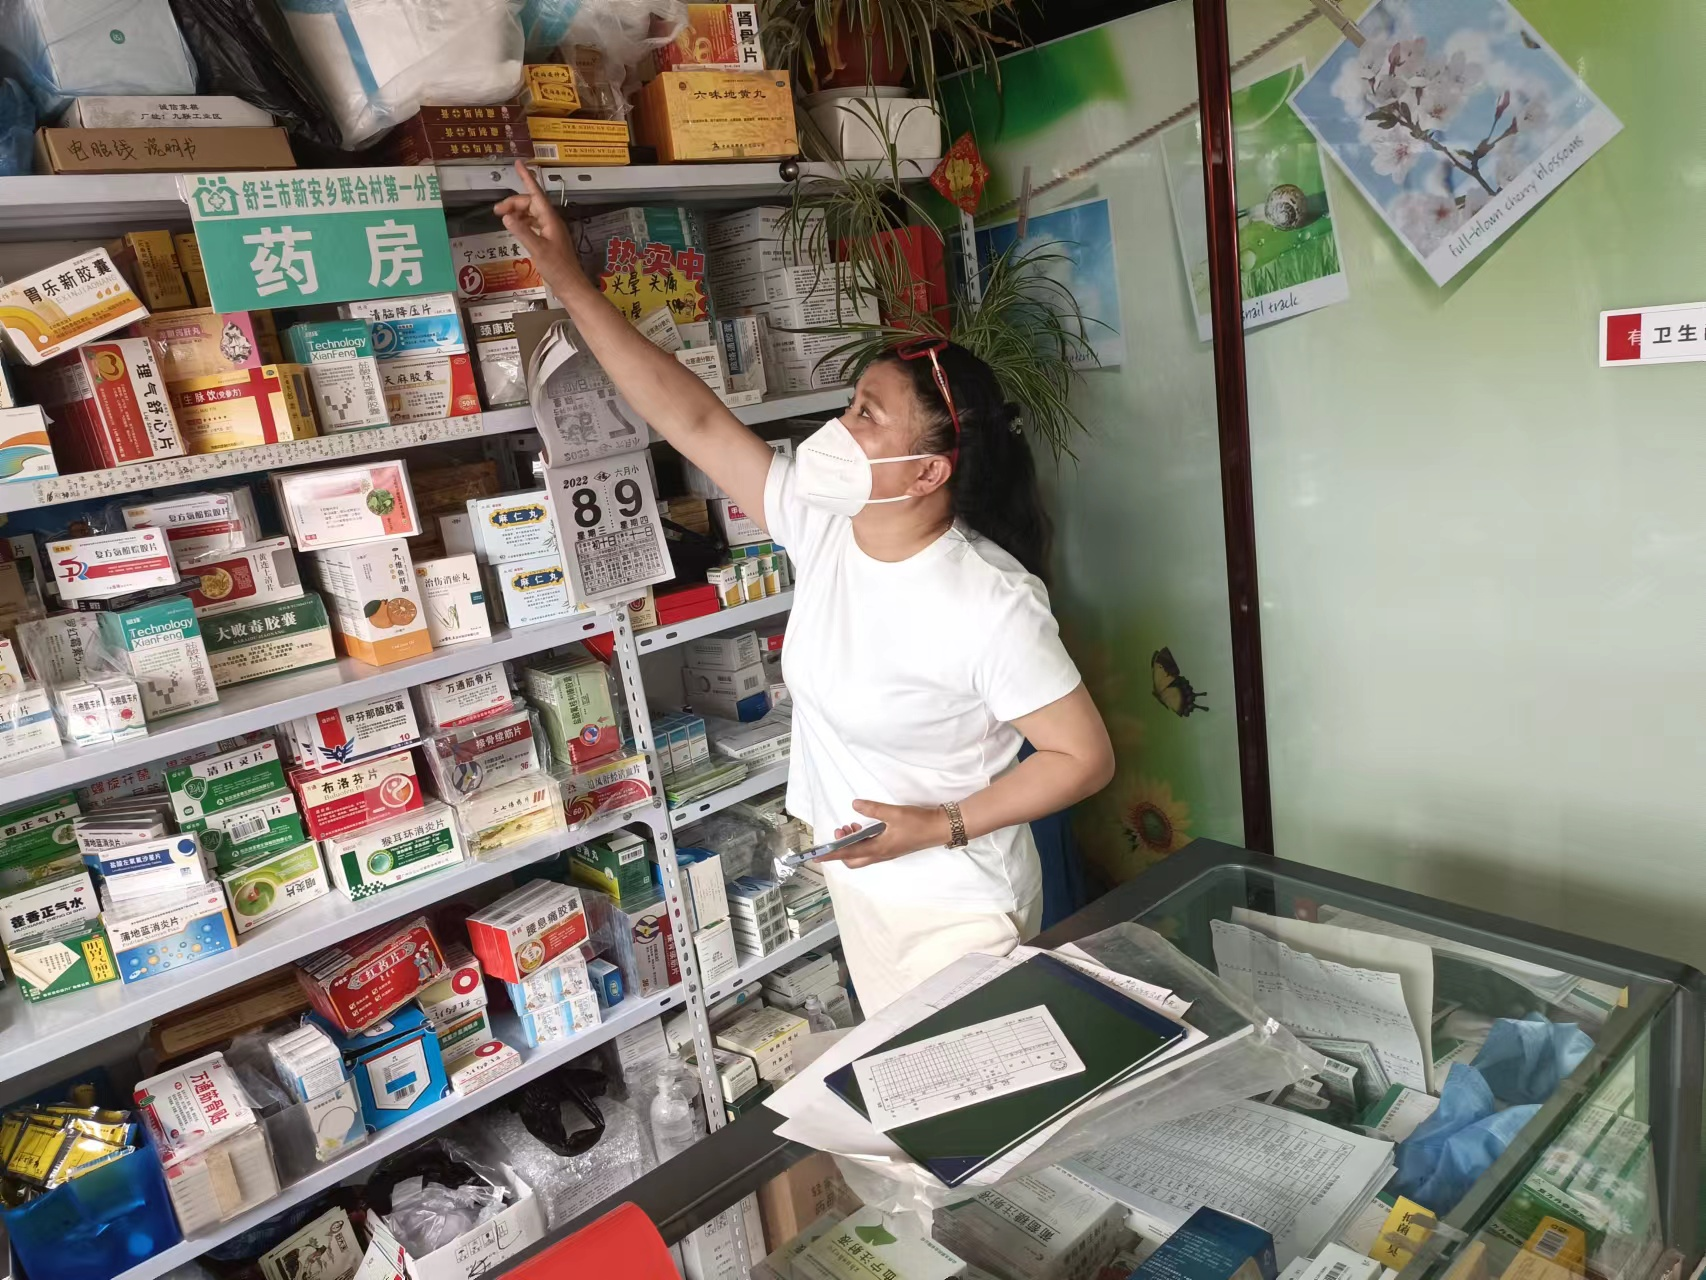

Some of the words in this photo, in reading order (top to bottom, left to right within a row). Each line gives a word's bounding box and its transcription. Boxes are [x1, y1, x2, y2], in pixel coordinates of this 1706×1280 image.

[737, 11, 757, 63] 肾骨片
[694, 89, 766, 100] 六味地黄丸
[159, 103, 200, 111] 诚信象棋
[144, 138, 196, 161] 说明书
[242, 173, 442, 211] 舒兰市新安乡联合村第一分室
[463, 243, 521, 262] 宁心宝胶囊
[607, 235, 705, 281] 热卖中
[23, 257, 112, 305] 胃乐新胶囊
[612, 271, 640, 297] 头晕
[648, 272, 678, 294] 头痛
[369, 304, 431, 321] 清脑降压片
[1269, 292, 1299, 313] track
[308, 337, 366, 352] Technology
[312, 349, 356, 361] XianFeng
[384, 370, 435, 386] 天麻胶囊
[136, 363, 175, 451] 理气舒心片
[563, 475, 589, 489] 2022
[614, 465, 639, 477] 六月小
[572, 488, 602, 528] 8
[614, 478, 643, 518] 9
[498, 511, 537, 524] 麻仁丸
[619, 516, 649, 530] 星期四
[577, 526, 607, 540] 星期三
[393, 553, 410, 593] 九维鱼肝油
[424, 573, 471, 588] 治伤消瘀丸
[520, 573, 559, 587] 麻仁丸
[130, 616, 193, 639] Technology
[215, 612, 297, 642] 大败毒胶囊
[133, 631, 183, 648] XianFeng
[446, 671, 493, 694] 万通筋骨片
[345, 700, 405, 725] 甲芬那酸胶囊
[399, 733, 411, 742] 10
[475, 726, 522, 750] 接骨续筋片
[207, 751, 264, 777] 清开灵片
[520, 762, 529, 771] 36
[322, 768, 378, 794] 布洛芬片
[381, 818, 445, 848] 猴耳环消炎片
[286, 877, 316, 897] 咽炎片
[10, 896, 84, 929] 藿香正气水
[525, 897, 578, 937] 腰息痛胶囊
[120, 917, 180, 942] 蒲地蓝消炎片
[190, 1070, 230, 1126] 万通筋骨贴
[977, 1189, 1055, 1242] 葡萄糖注射液
